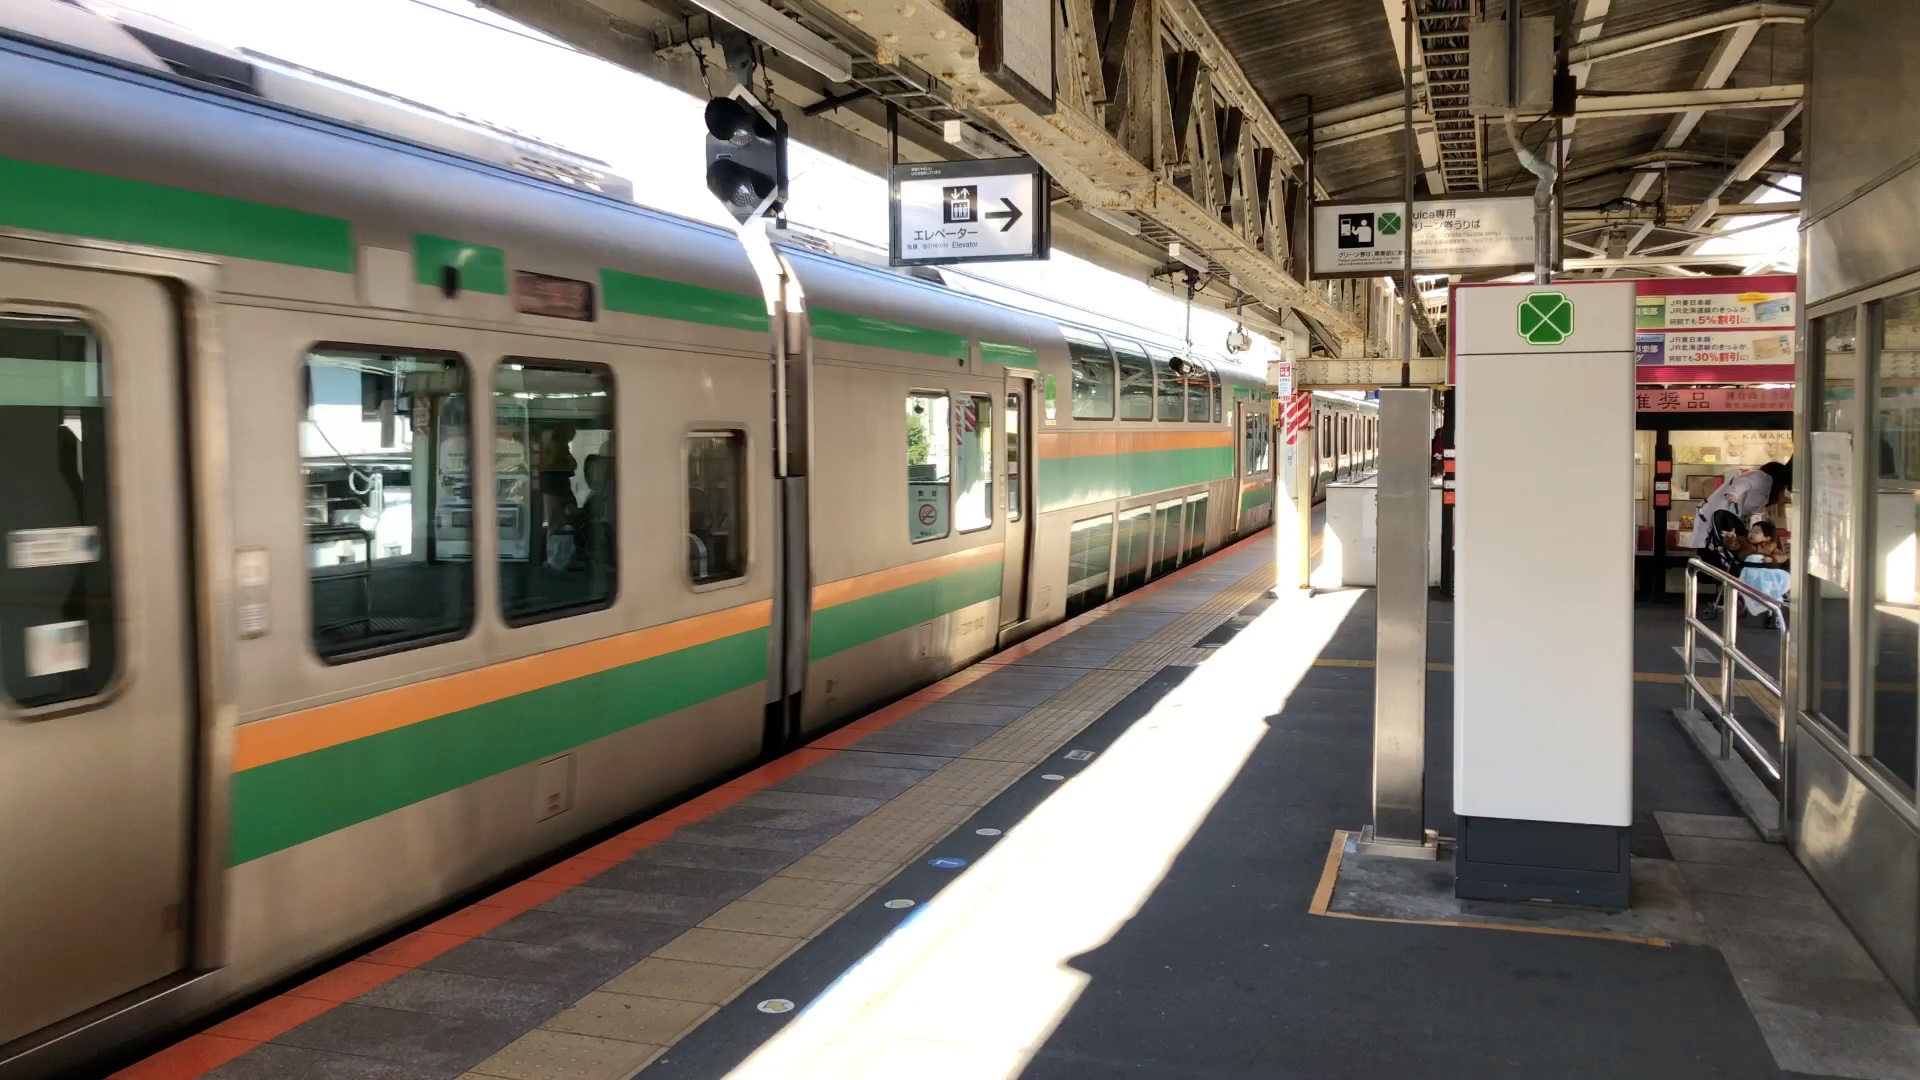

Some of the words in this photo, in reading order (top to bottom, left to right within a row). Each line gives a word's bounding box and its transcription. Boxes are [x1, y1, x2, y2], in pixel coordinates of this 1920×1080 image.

[1411, 208, 1456, 219] uica専用
[1411, 219, 1481, 232] リーン券うりば
[914, 227, 978, 241] エレベーター
[952, 240, 978, 249] Elevator
